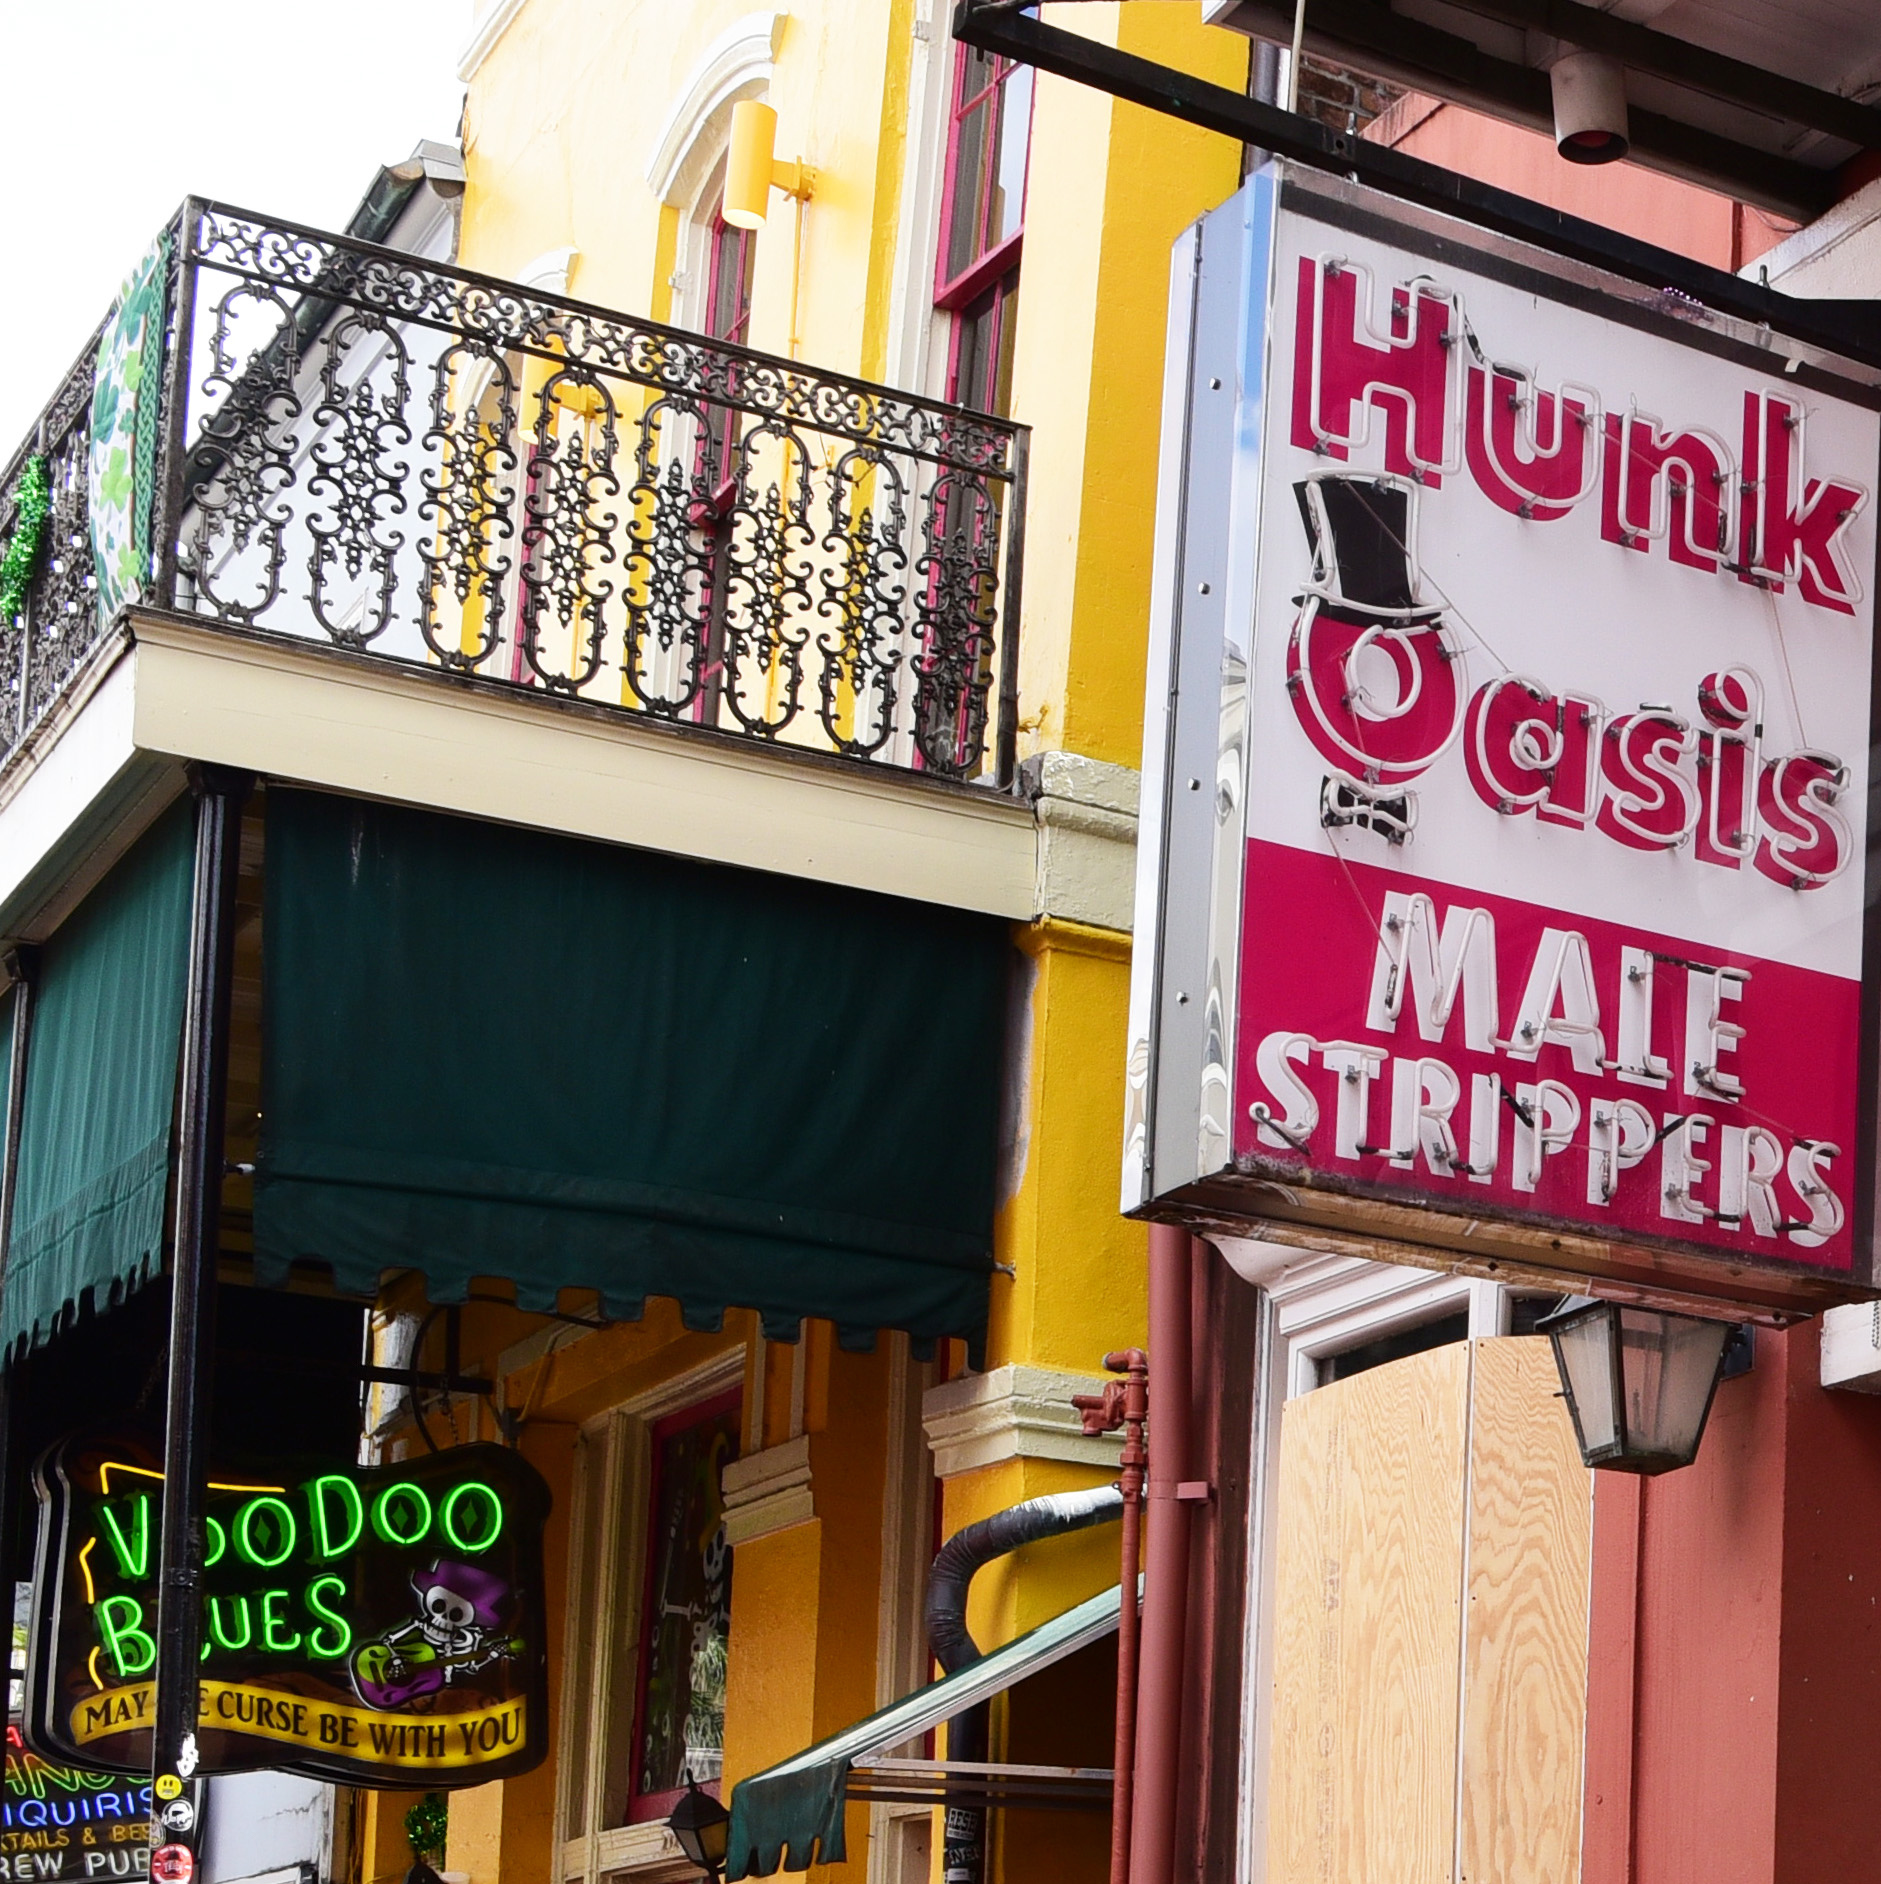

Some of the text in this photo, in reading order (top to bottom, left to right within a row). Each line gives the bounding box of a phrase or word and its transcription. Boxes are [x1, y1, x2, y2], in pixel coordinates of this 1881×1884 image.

[1289, 249, 1870, 617] Hunk
[1286, 598, 1854, 891] Oasis
[1364, 891, 1752, 1103] MALE
[1248, 1029, 1846, 1249] STRIPPERS
[85, 1693, 149, 1735] MAY
[216, 1689, 309, 1736] CURSE
[319, 1713, 360, 1748] BE
[368, 1721, 447, 1758] WITH
[459, 1706, 522, 1757] YOU
[94, 1573, 353, 1678] BUES
[85, 1847, 150, 1877] PUB
